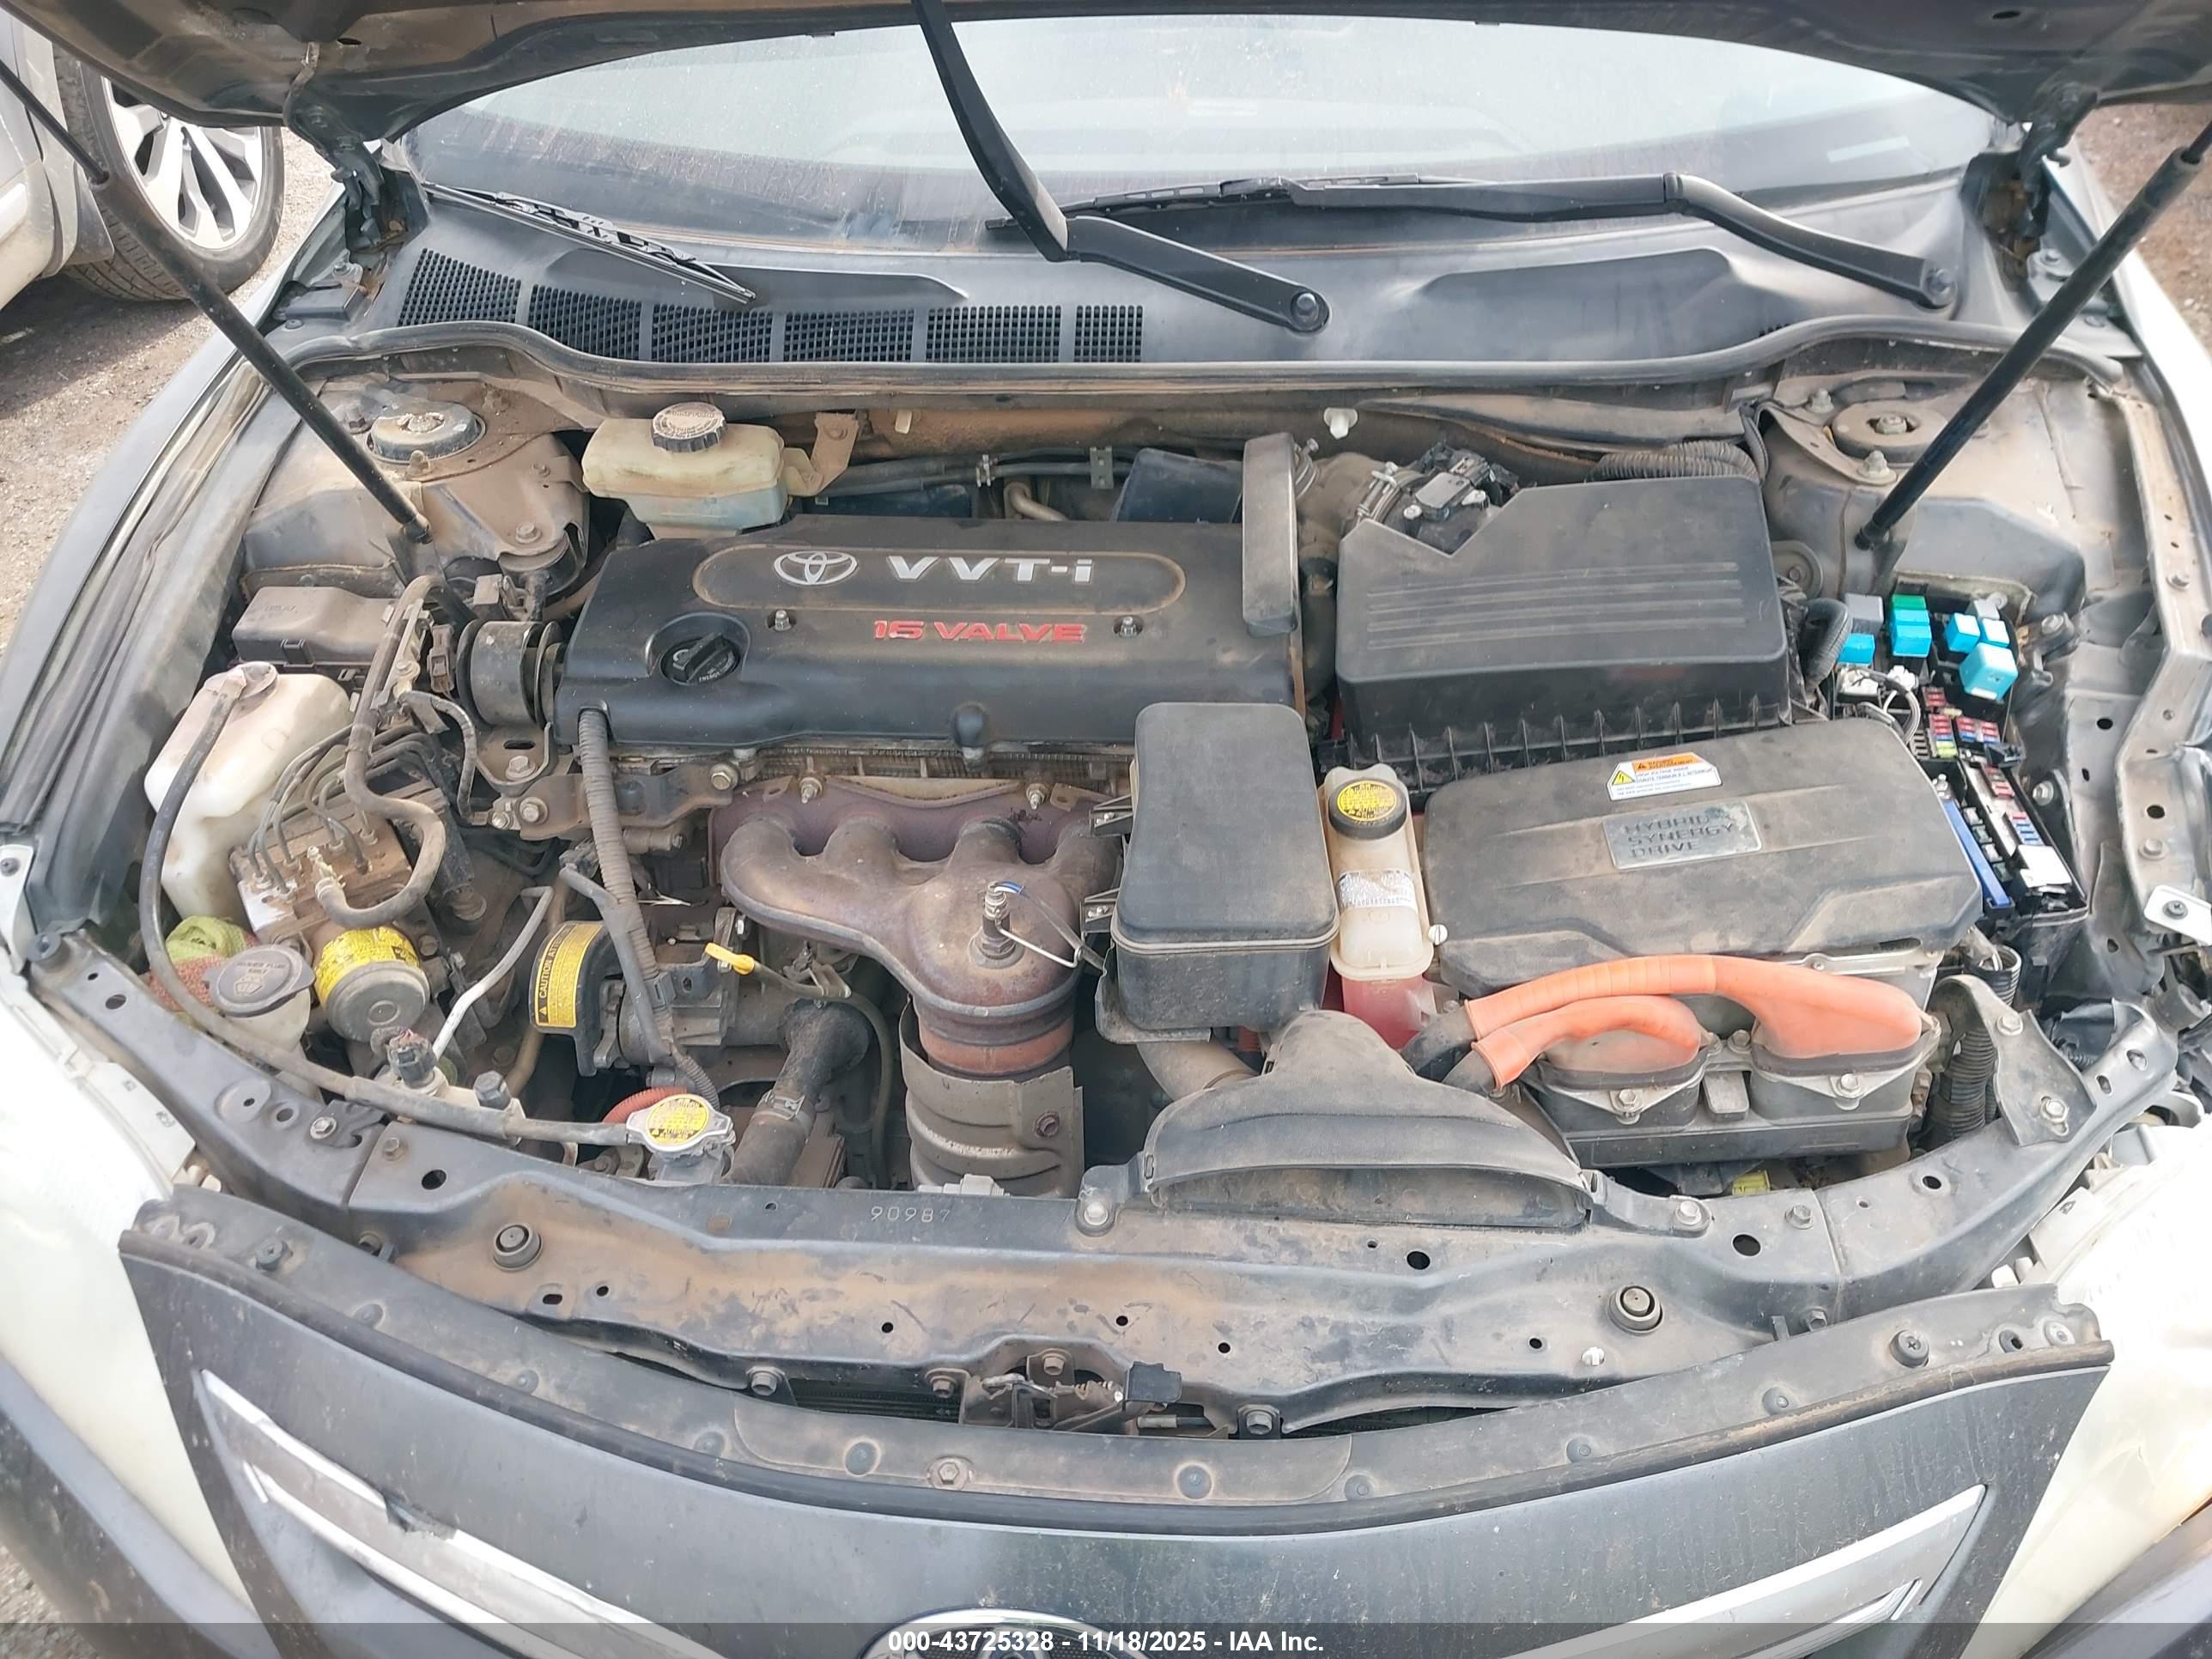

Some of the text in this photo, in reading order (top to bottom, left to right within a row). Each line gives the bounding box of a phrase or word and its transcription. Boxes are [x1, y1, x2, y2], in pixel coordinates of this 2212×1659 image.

[888, 555, 1093, 583] VVT-i
[873, 620, 1086, 642] 16 VALVE
[1624, 815, 1710, 834] HYBRID
[1627, 823, 1733, 847] SYNERGY
[1632, 841, 1700, 859] DRIVE
[538, 957, 554, 999] CAUTION
[871, 1206, 951, 1223] 90987
